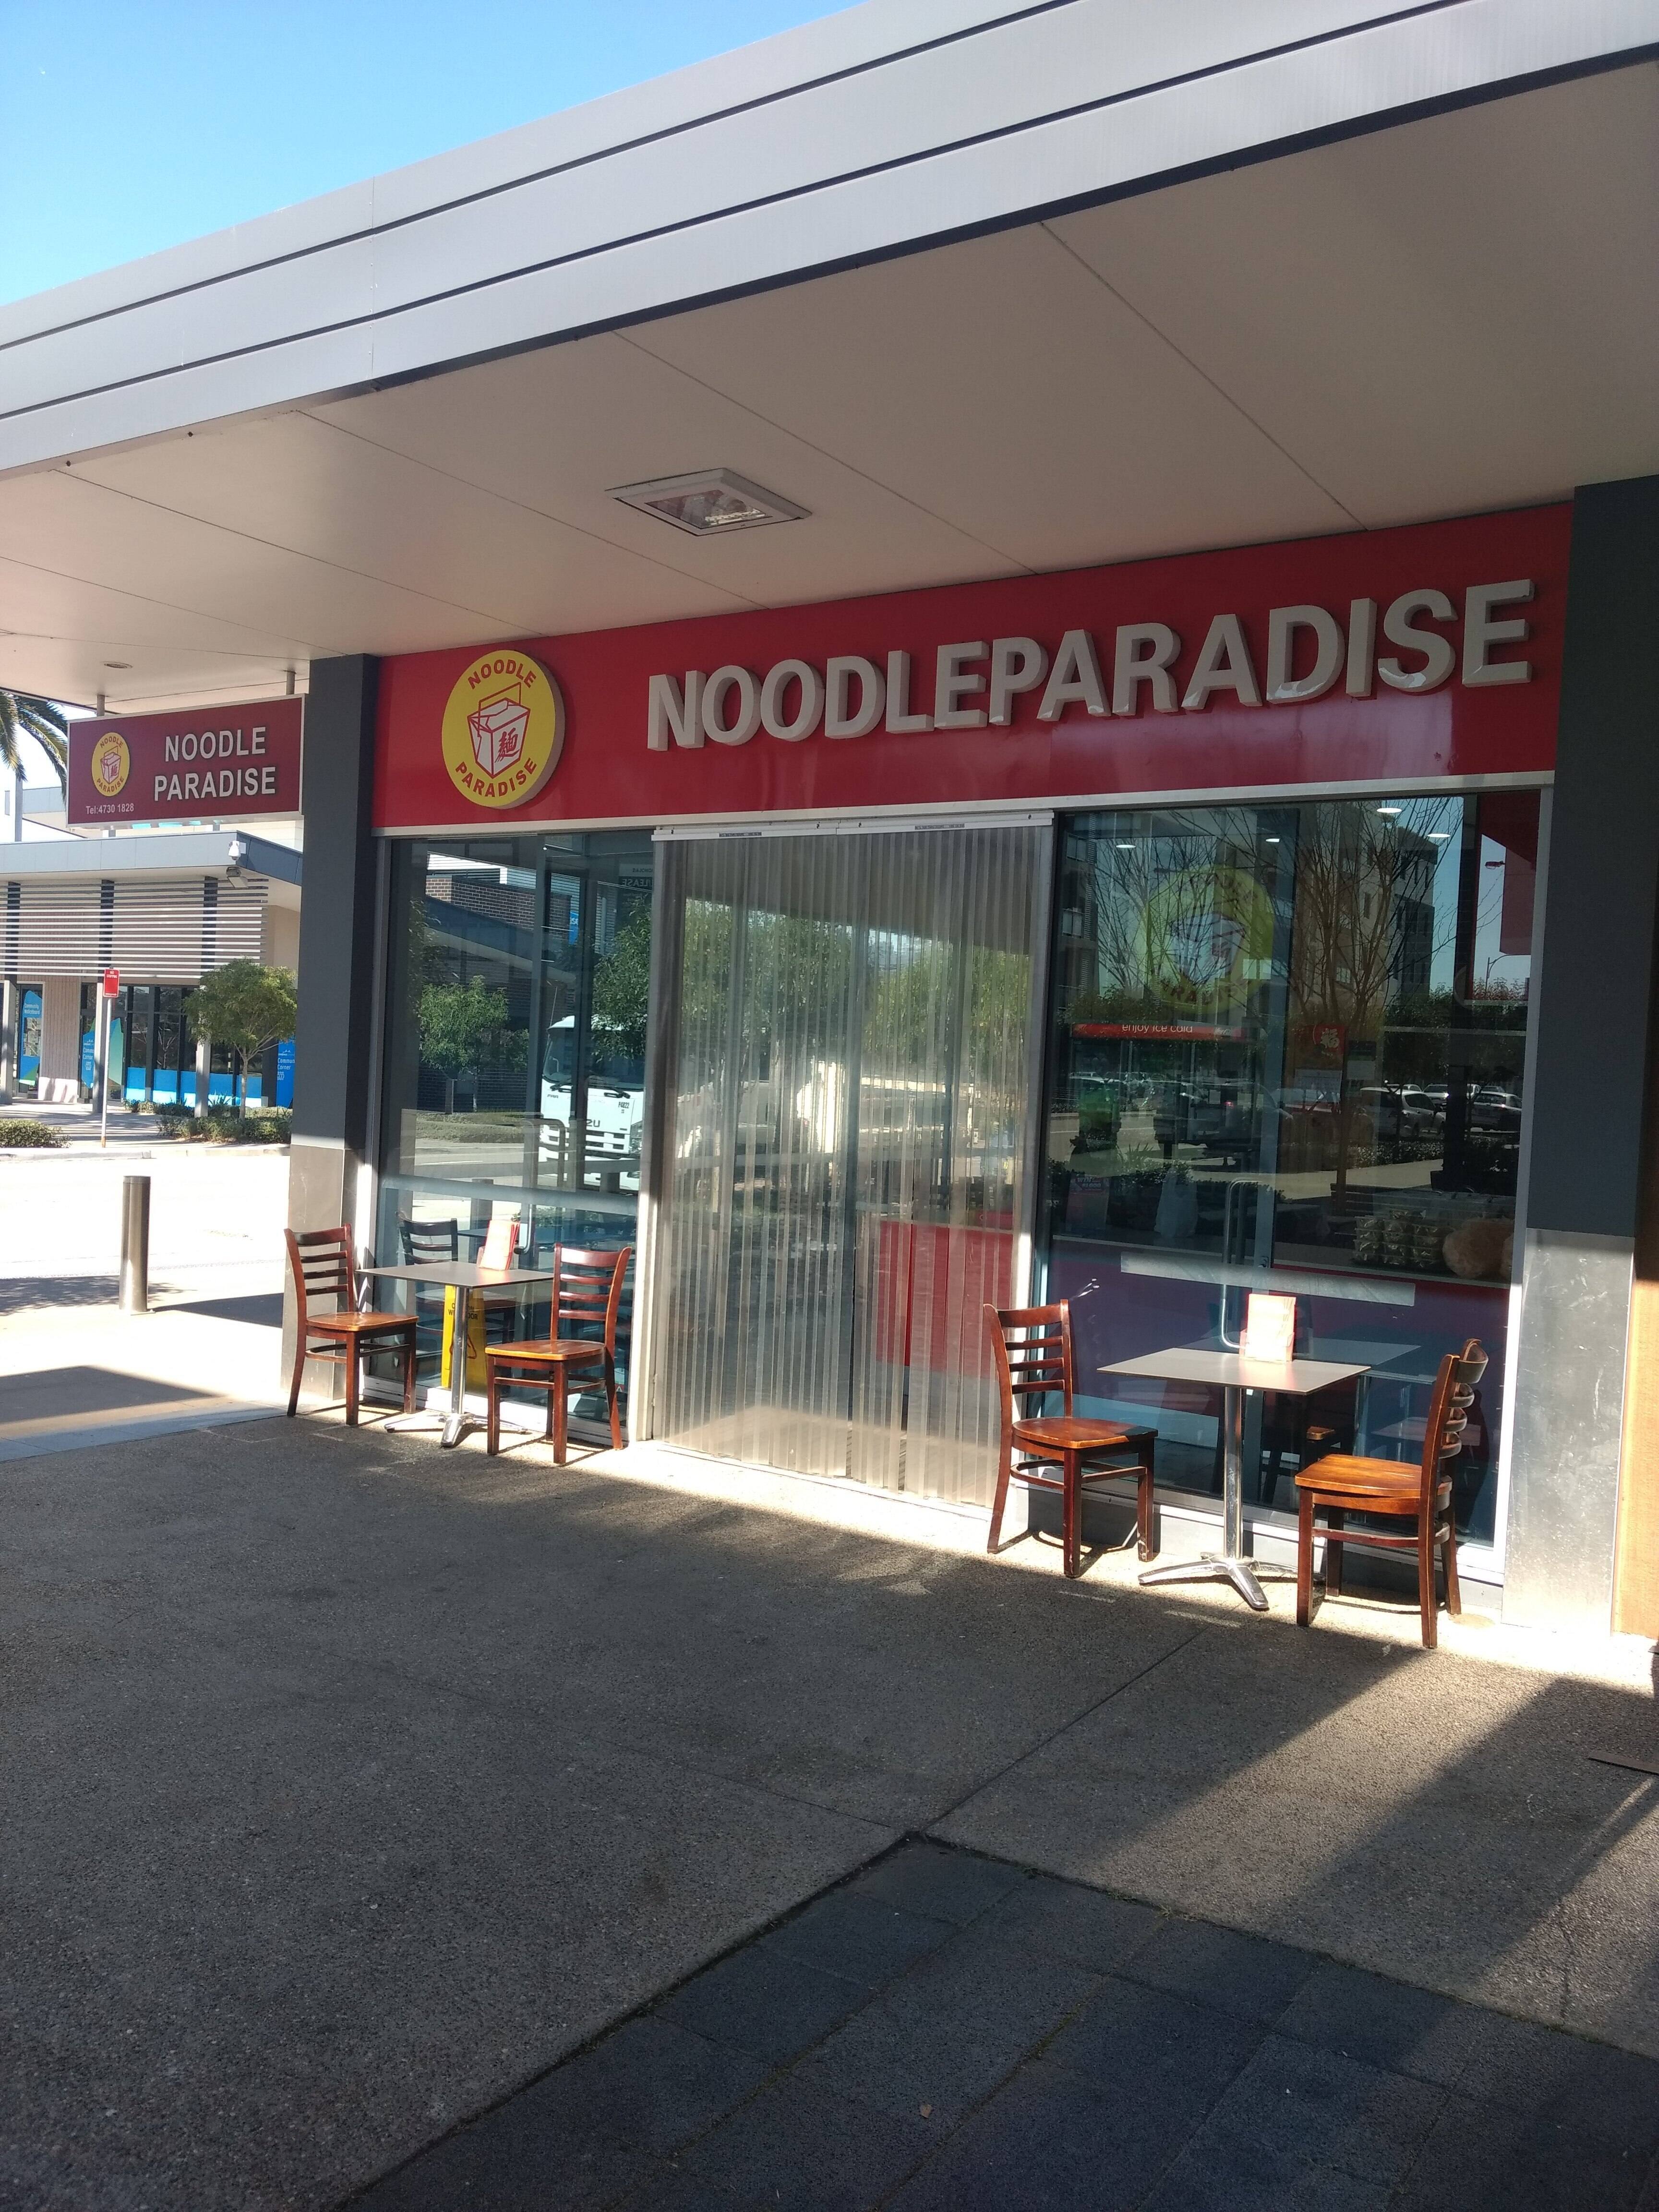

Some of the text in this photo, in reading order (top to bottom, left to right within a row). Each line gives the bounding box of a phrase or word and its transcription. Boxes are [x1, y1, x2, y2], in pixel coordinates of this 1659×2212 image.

[467, 659, 537, 690] NOODLE
[99, 736, 123, 748] NOODLE
[165, 726, 266, 762] NOODLE
[96, 776, 124, 793] PARADISE
[154, 767, 276, 801] PARADISE
[455, 757, 538, 797] PARADISE
[86, 803, 134, 815] Tel:4730 1828
